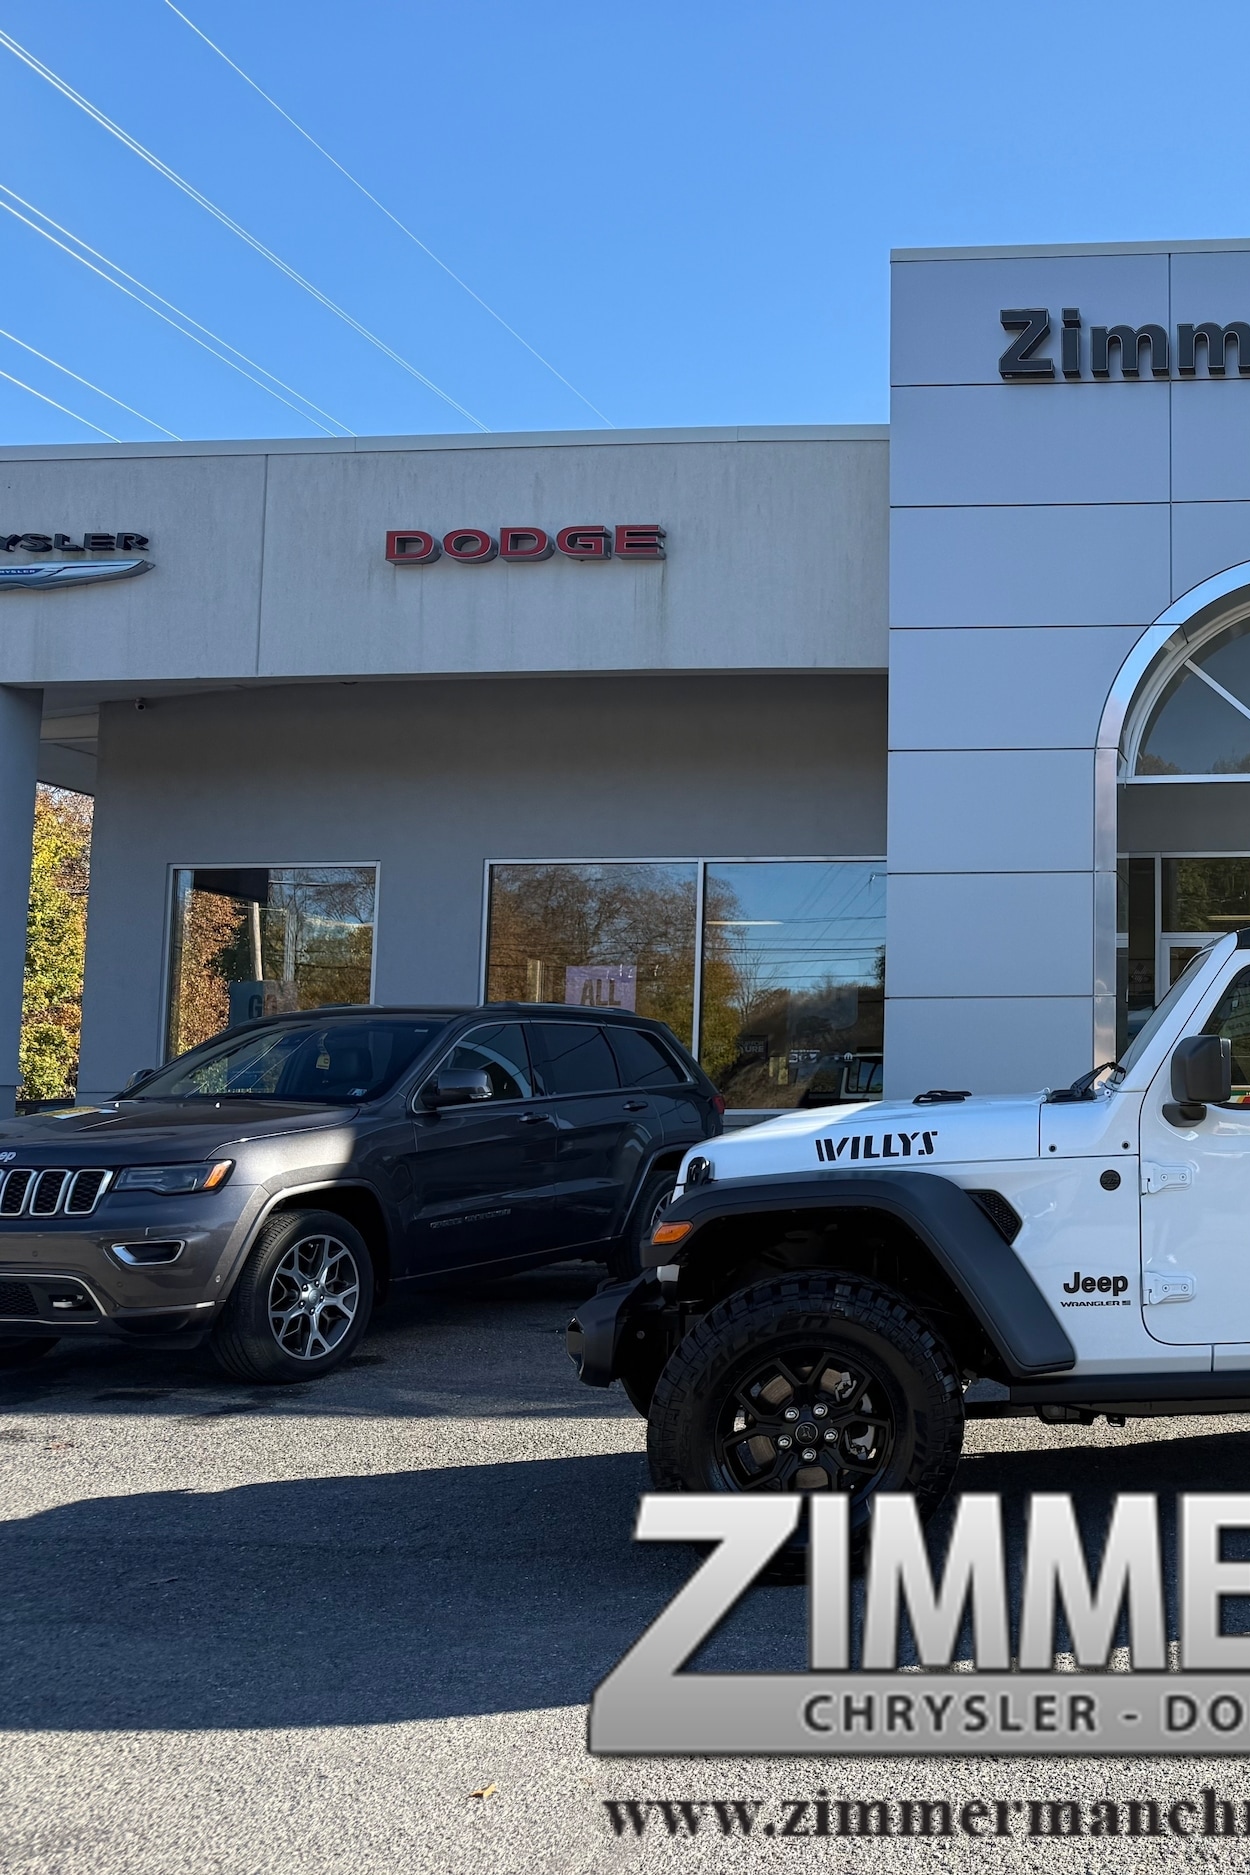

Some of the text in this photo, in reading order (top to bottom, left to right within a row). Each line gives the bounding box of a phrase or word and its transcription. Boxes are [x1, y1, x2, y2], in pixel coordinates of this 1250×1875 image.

[385, 524, 667, 566] DODGE
[580, 978, 621, 1007] ALL
[815, 1131, 938, 1161] WILLYS
[1063, 1271, 1128, 1297] Jeep
[1060, 1300, 1120, 1308] WRANGLER
